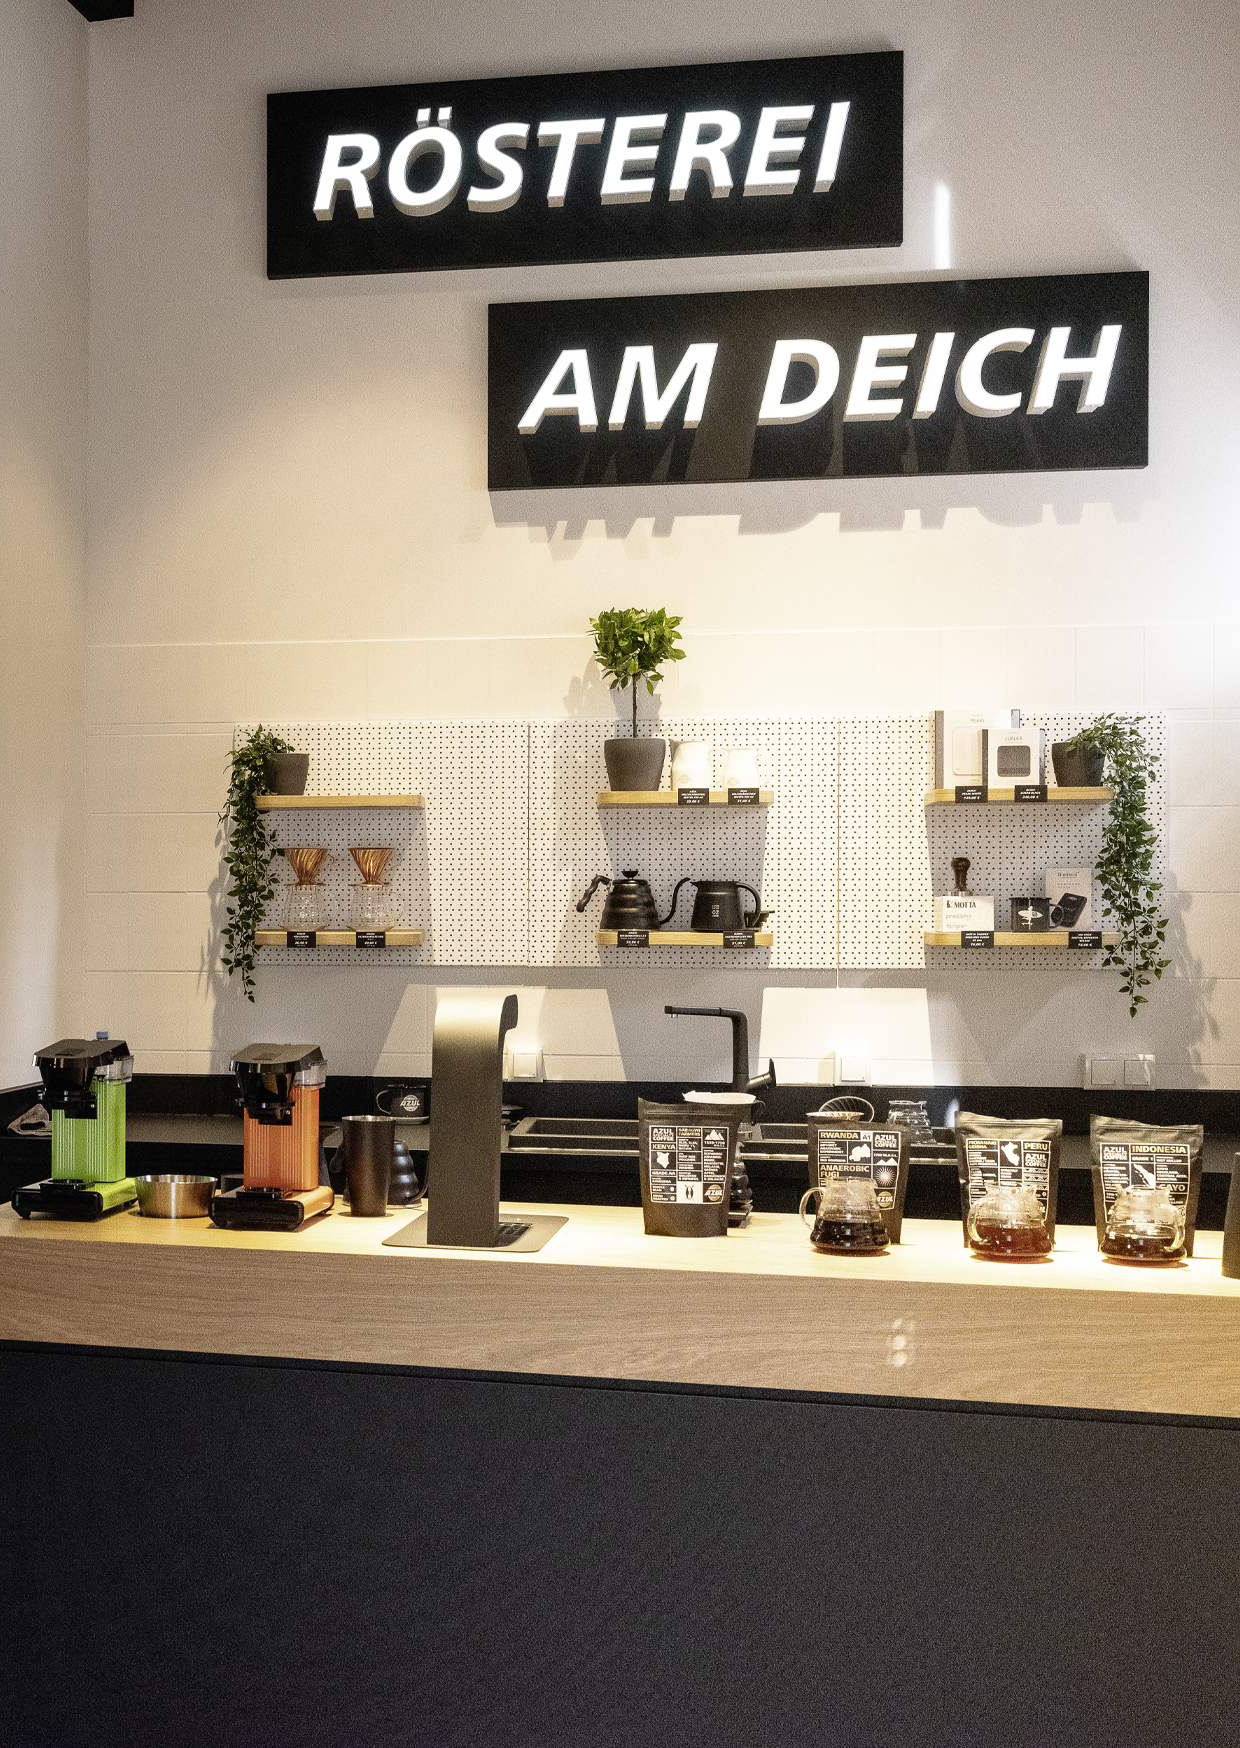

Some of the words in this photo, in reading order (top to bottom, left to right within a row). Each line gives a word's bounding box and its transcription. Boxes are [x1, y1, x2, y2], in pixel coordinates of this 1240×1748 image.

[314, 100, 852, 220] RÖSTEREI
[517, 342, 719, 434] AM
[757, 324, 1123, 426] DEICH
